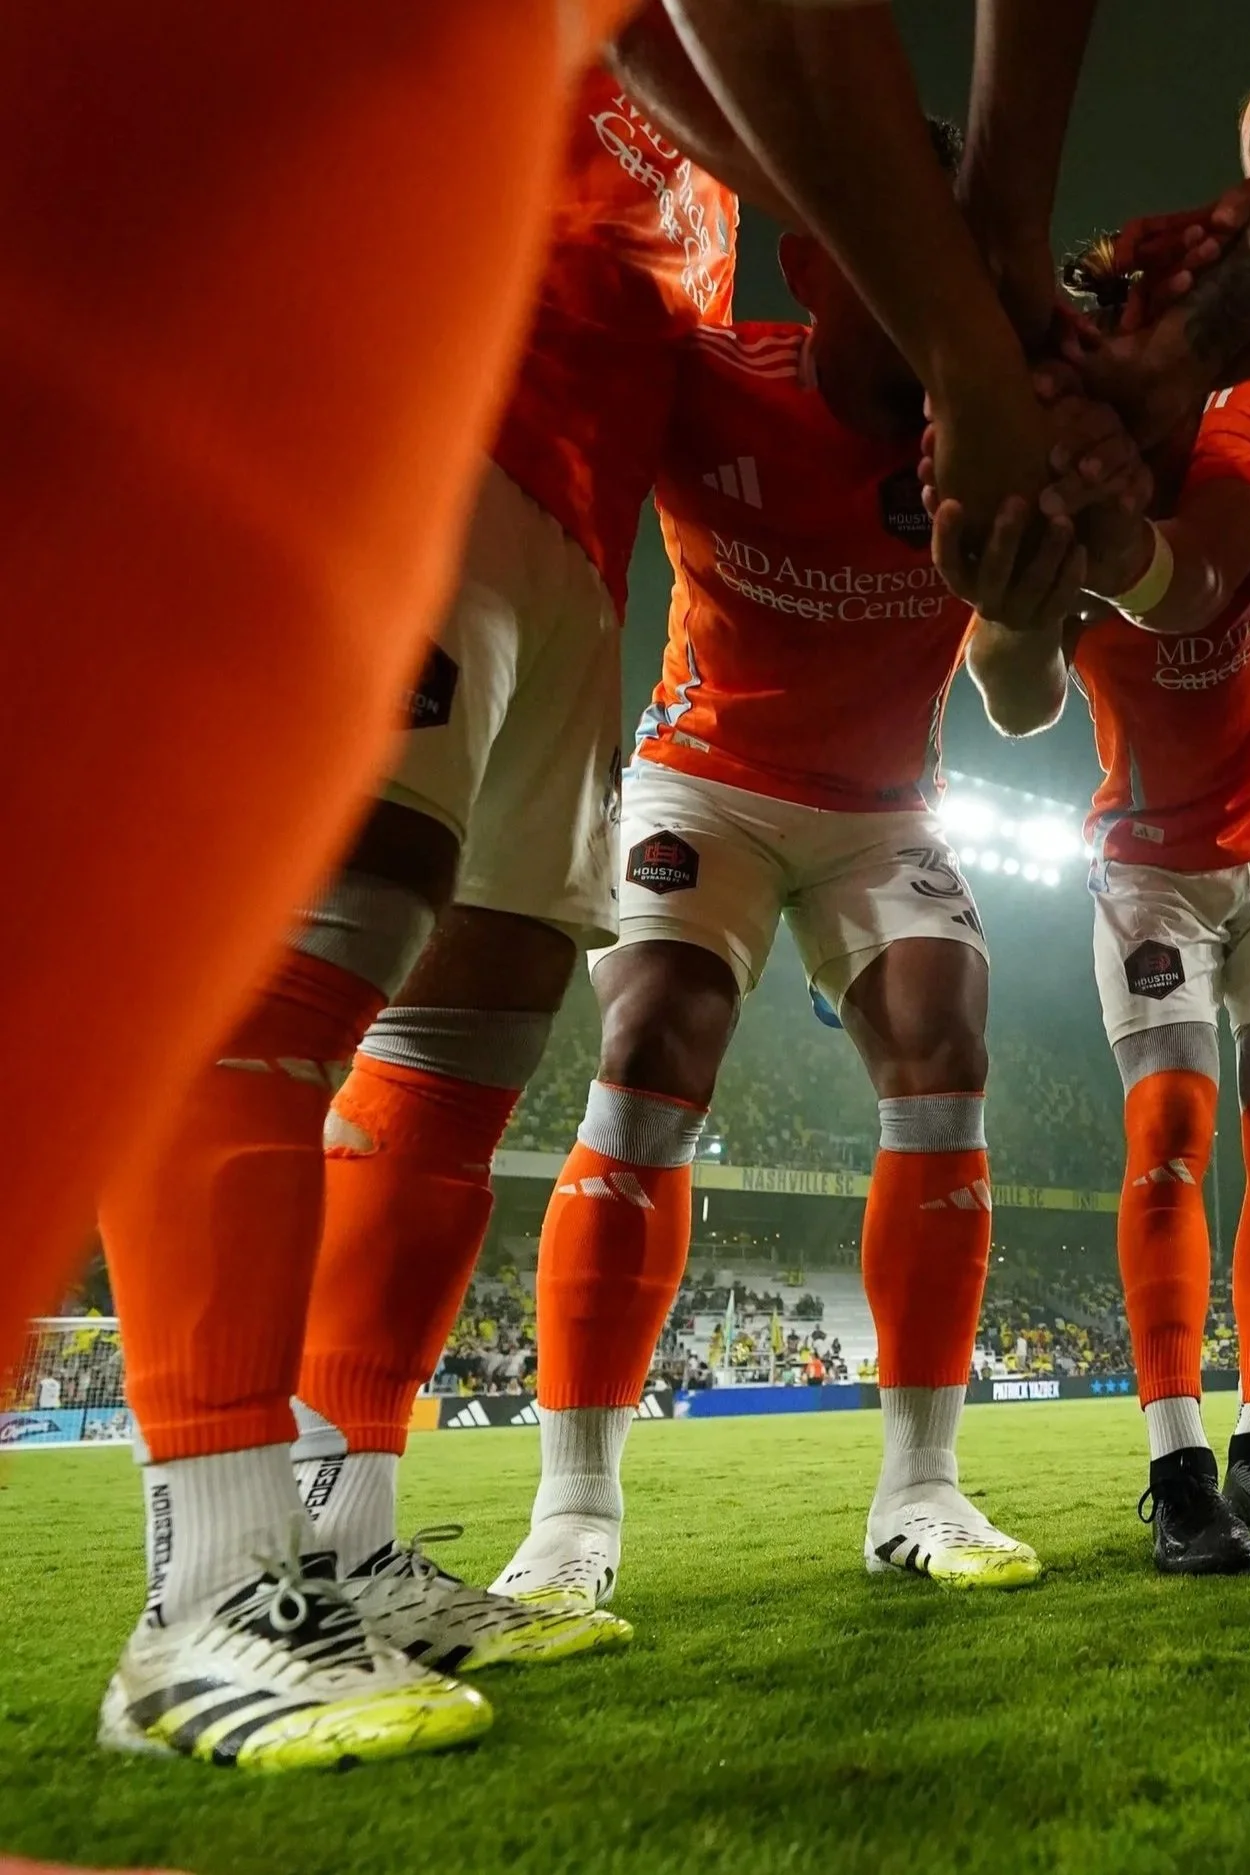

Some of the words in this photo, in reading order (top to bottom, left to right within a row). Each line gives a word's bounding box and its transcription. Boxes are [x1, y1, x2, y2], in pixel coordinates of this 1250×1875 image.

[888, 513, 933, 525] HOUST
[711, 530, 770, 575] MD
[714, 560, 835, 623] Cancer
[837, 594, 951, 622] Center
[1155, 637, 1214, 666] MD
[633, 866, 690, 881] HOUSTON
[1134, 972, 1179, 987] HOUSTON
[742, 1168, 828, 1193] NASHVILLE
[835, 1174, 855, 1195] SC
